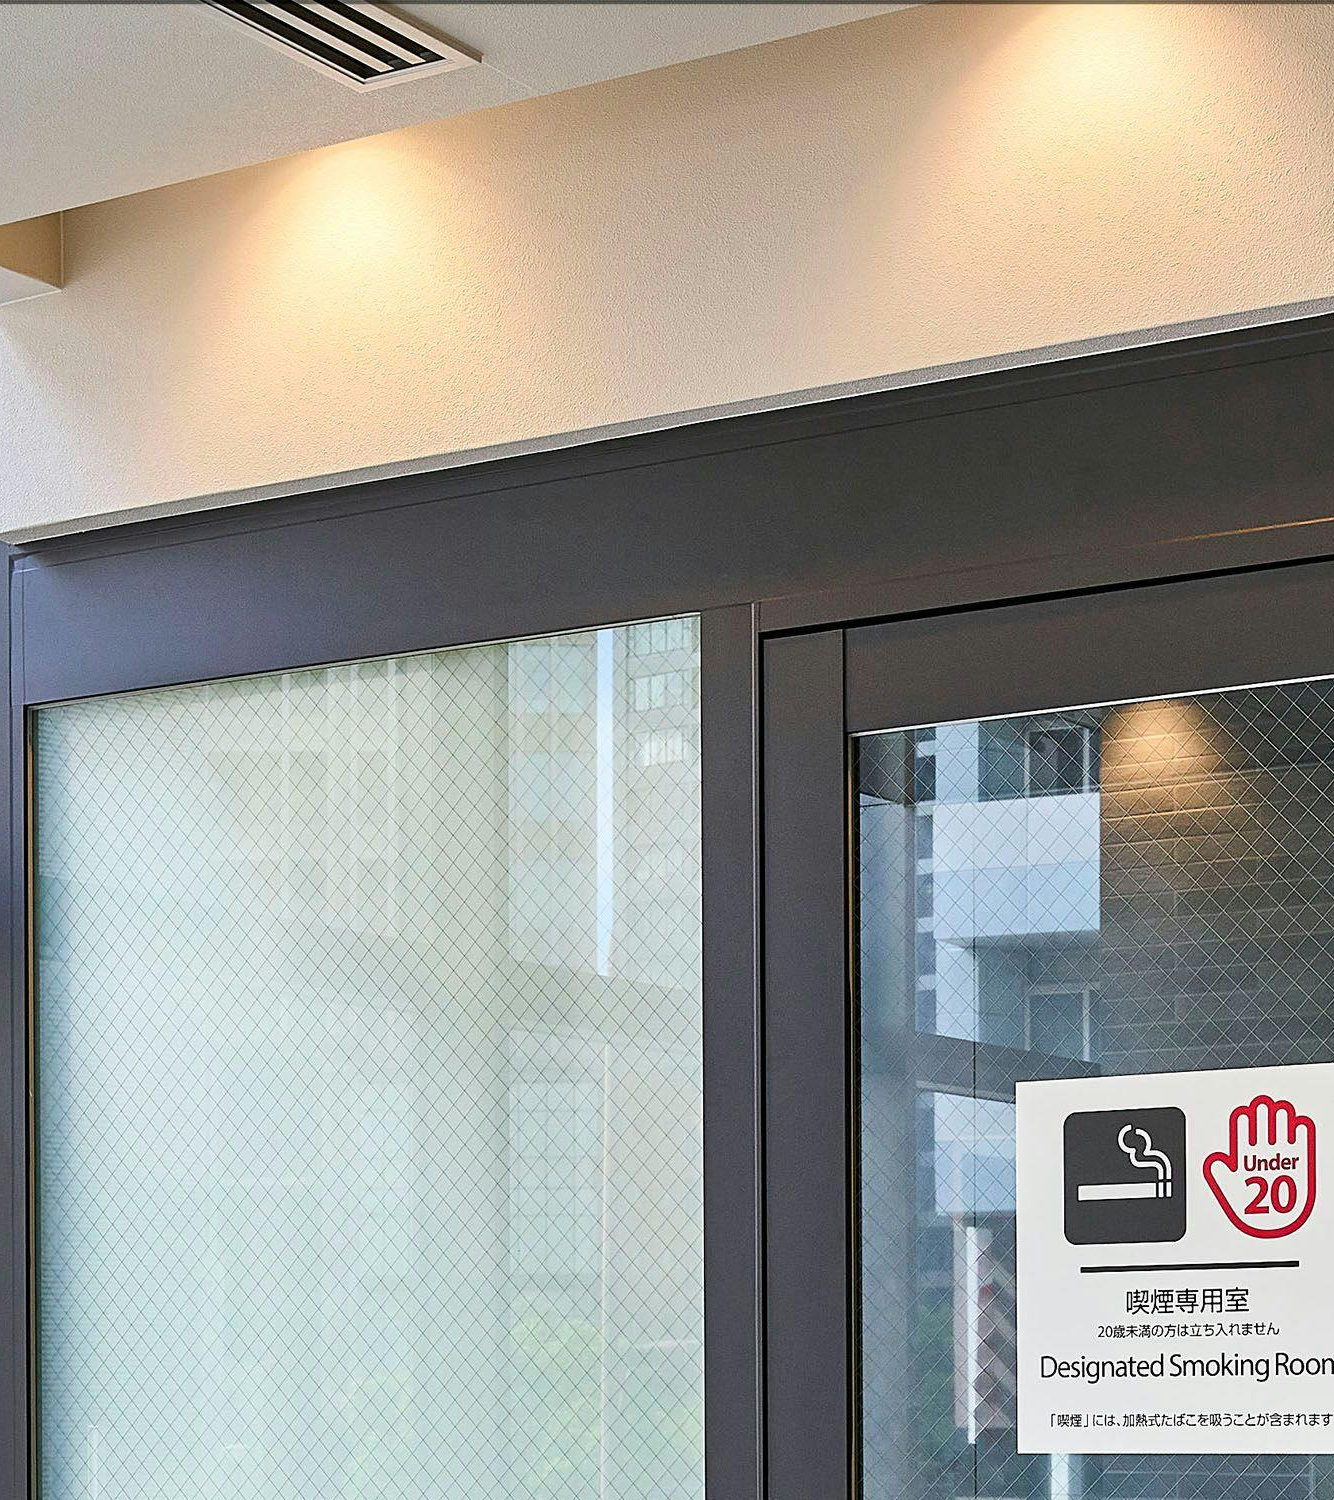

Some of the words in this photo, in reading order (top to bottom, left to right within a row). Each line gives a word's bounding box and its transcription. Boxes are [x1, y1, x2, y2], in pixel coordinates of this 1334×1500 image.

[1244, 1153, 1299, 1172] Under
[1244, 1175, 1298, 1216] 20
[1126, 1286, 1250, 1315] 喫煙専用室
[1097, 1321, 1280, 1339] 20歳未満の方は立ち入れません
[1040, 1353, 1165, 1384] Designated
[1169, 1352, 1270, 1382] Smoking
[1049, 1412, 1334, 1428] 「喫煙」には、加熱式たばこを吸うことが含まれます
